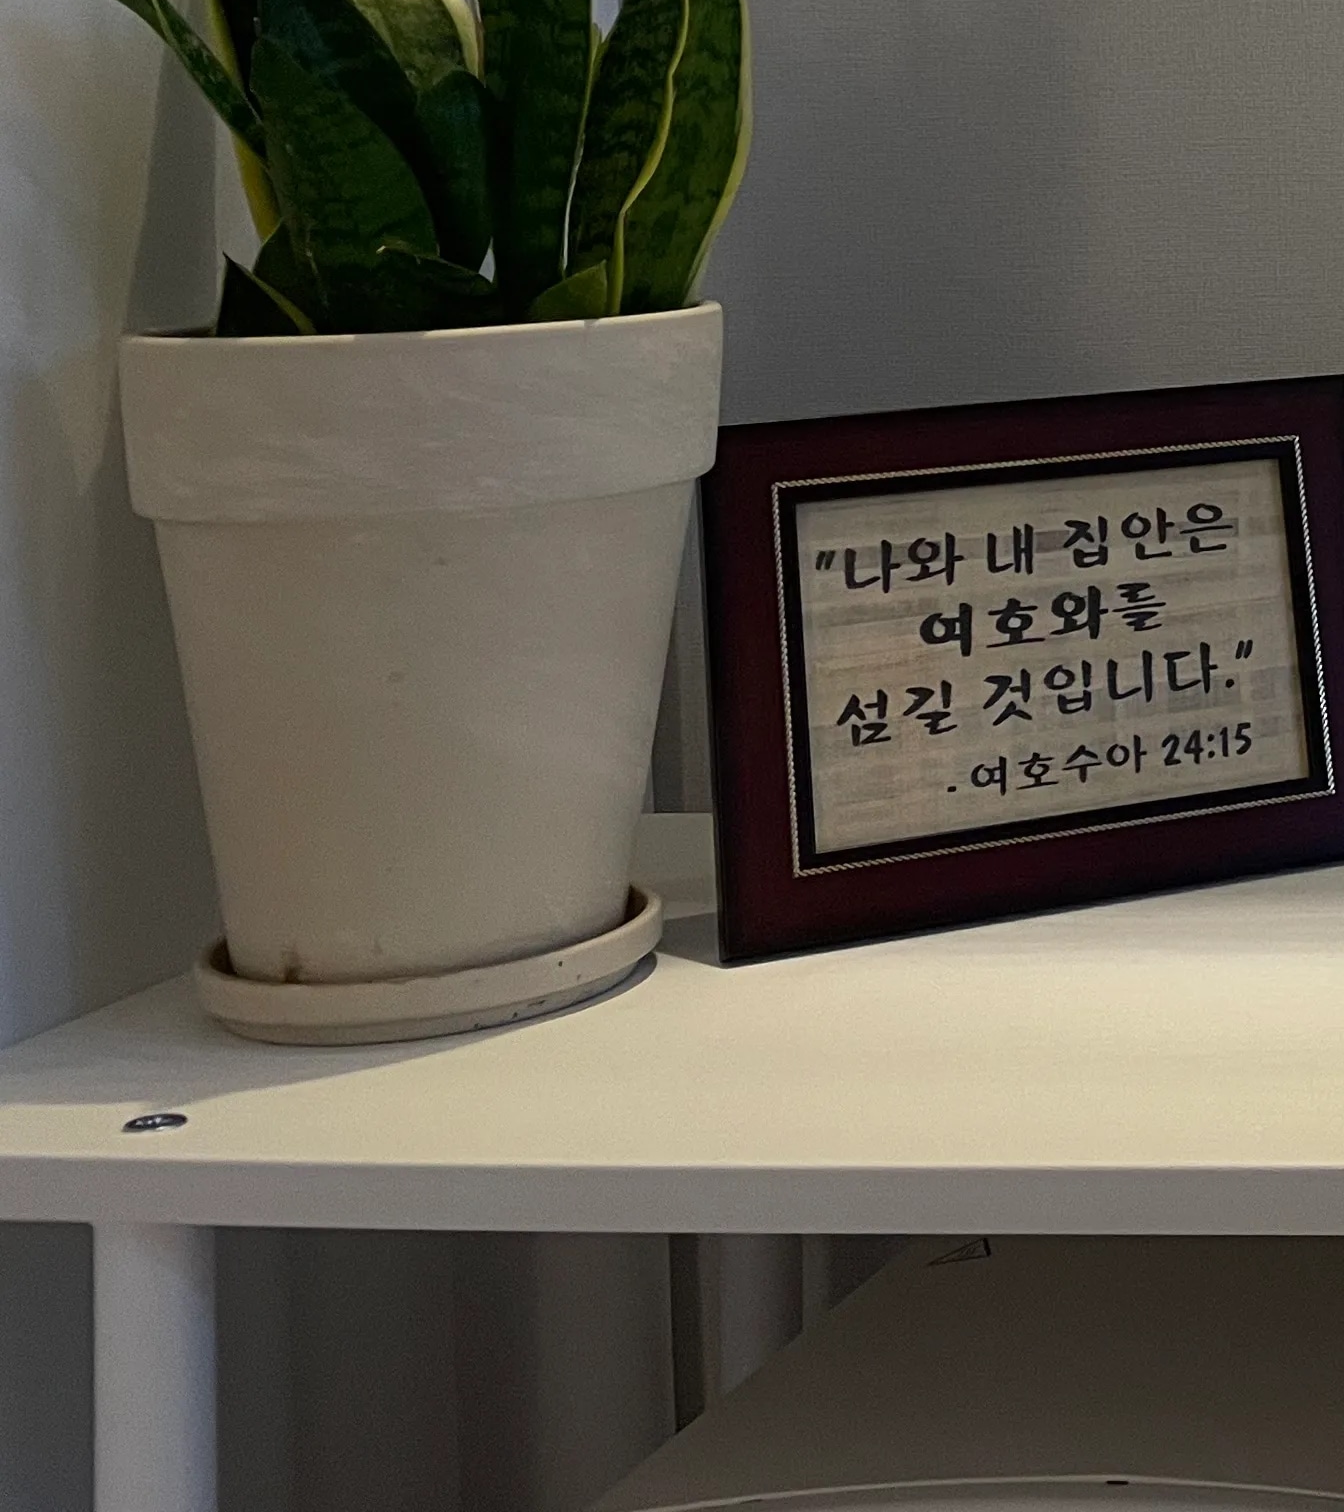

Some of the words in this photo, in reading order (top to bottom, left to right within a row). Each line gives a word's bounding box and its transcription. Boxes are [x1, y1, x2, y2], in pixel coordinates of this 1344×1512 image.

[814, 531, 964, 594] "나와
[986, 523, 1035, 576] 내
[1061, 501, 1236, 569] 집안은
[918, 580, 1168, 658] 여호와를
[834, 680, 958, 747] 섬길
[981, 639, 1254, 727] 것입니다."
[1161, 721, 1253, 767] 24:15
